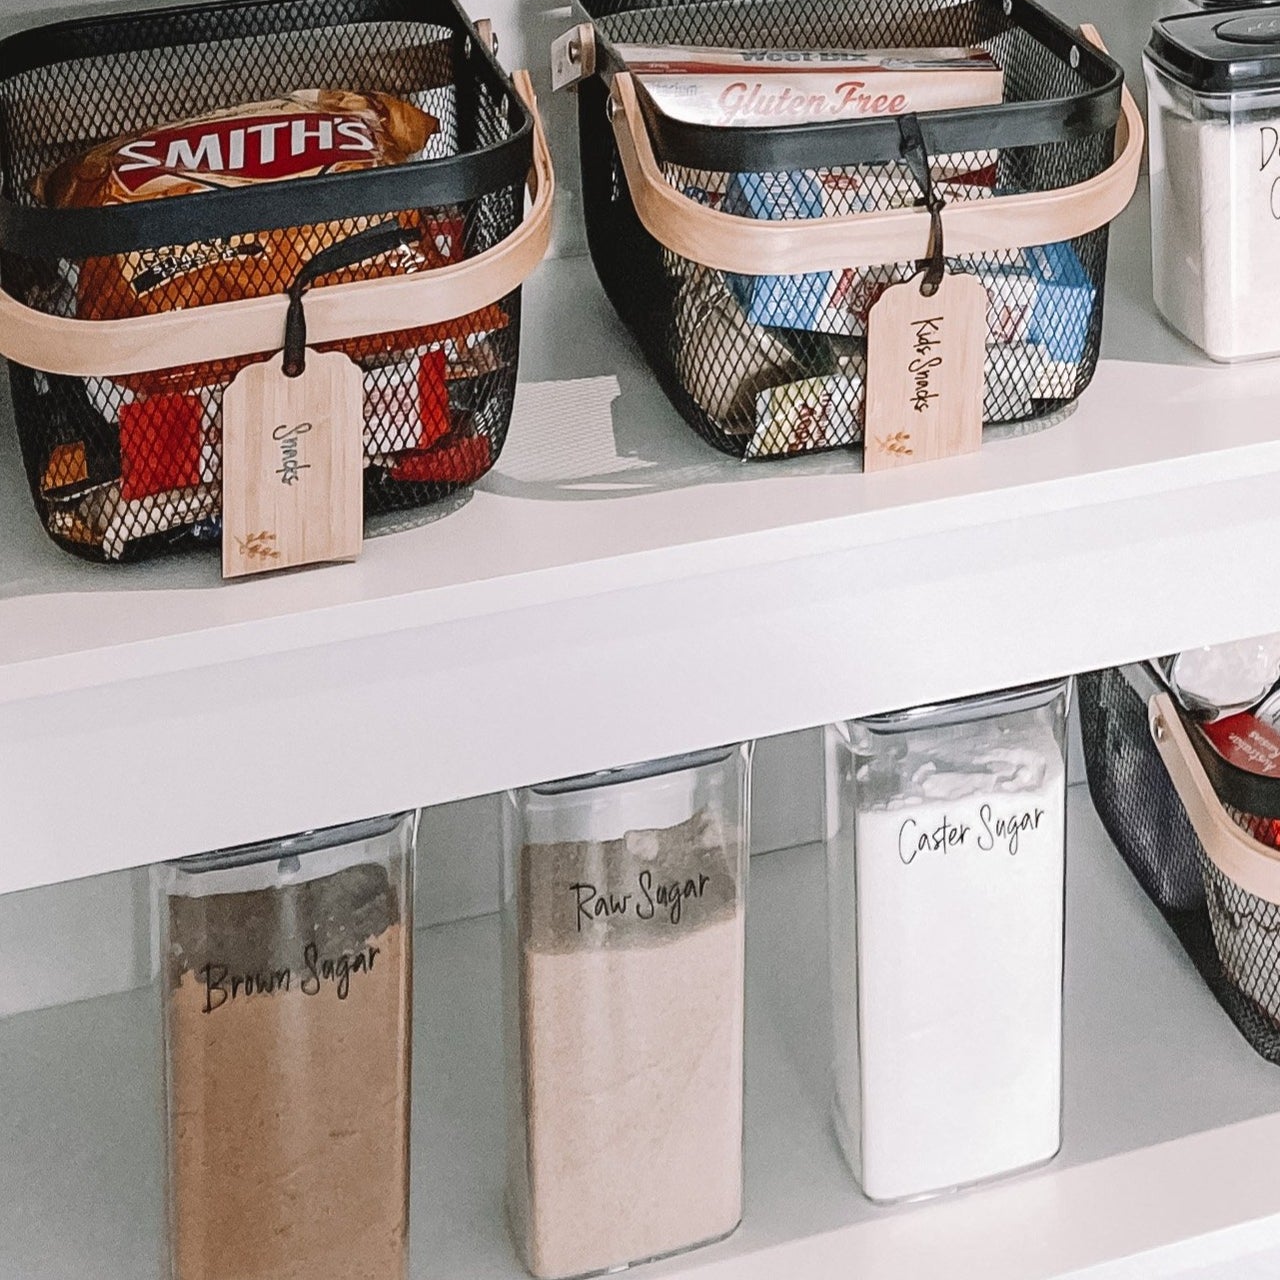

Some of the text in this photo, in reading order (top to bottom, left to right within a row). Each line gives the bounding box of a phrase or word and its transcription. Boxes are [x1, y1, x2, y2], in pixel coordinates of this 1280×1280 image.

[719, 80, 907, 124] Gluten Free
[118, 118, 375, 172] SMITH'S
[908, 316, 944, 413] Kids Snacks
[273, 422, 313, 487] Snacks
[899, 803, 1044, 865] Caster Sugar
[569, 870, 710, 932] Raw Sugar
[201, 942, 380, 1014] Brown Sugar
